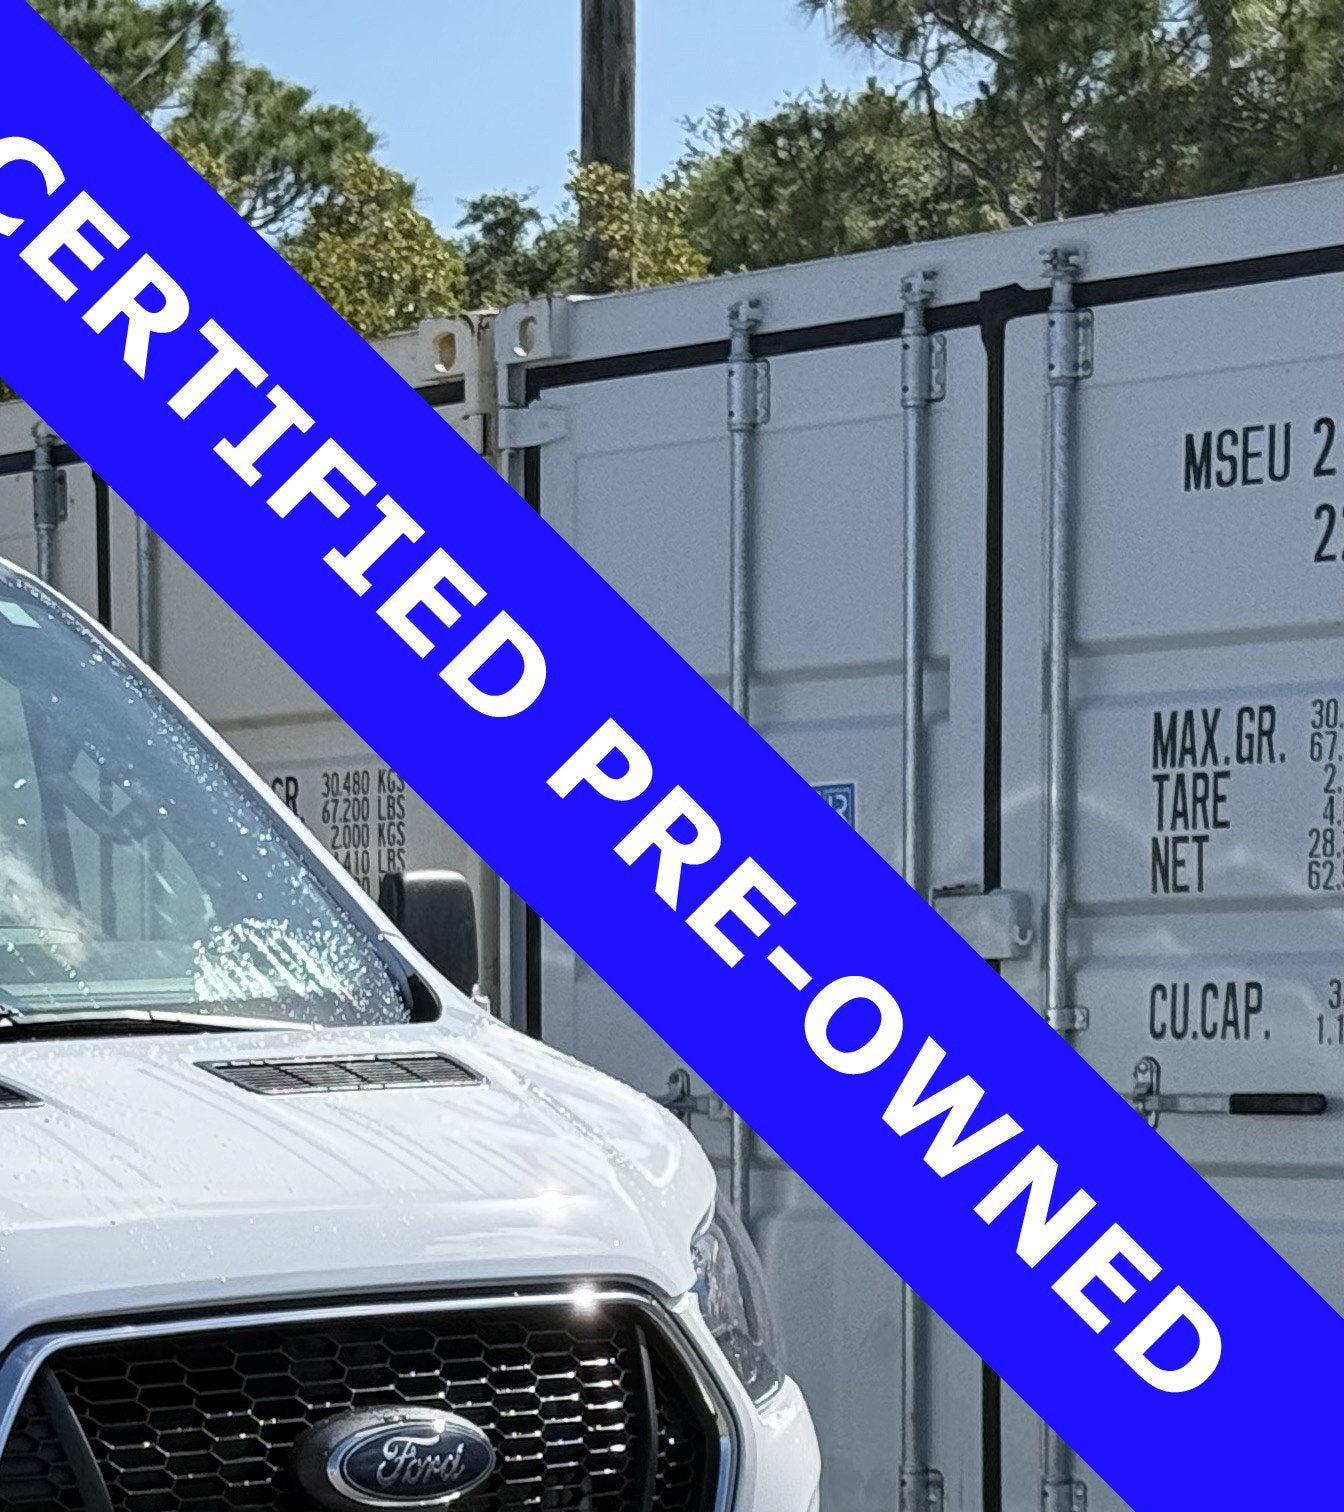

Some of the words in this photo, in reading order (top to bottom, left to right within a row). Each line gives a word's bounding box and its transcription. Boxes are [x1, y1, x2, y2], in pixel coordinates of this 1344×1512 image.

[1184, 421, 1292, 492] MSEU
[1313, 416, 1337, 478] 2
[1314, 502, 1344, 563] 2
[1151, 705, 1287, 770] MAX.GR.
[321, 770, 370, 798] 30.480
[1151, 771, 1231, 831] TARE
[321, 798, 370, 824] 67.200
[378, 795, 406, 821] LBS
[1323, 795, 1344, 826] 4.
[331, 823, 370, 850] 2.000
[378, 821, 406, 847] KGS
[1308, 827, 1344, 859] 28.
[1151, 834, 1210, 895] NET
[1308, 859, 1344, 891] 62.
[1149, 981, 1272, 1042] CU.CAP.
[1328, 978, 1344, 1009] 3
[376, 1435, 466, 1488] Ford
